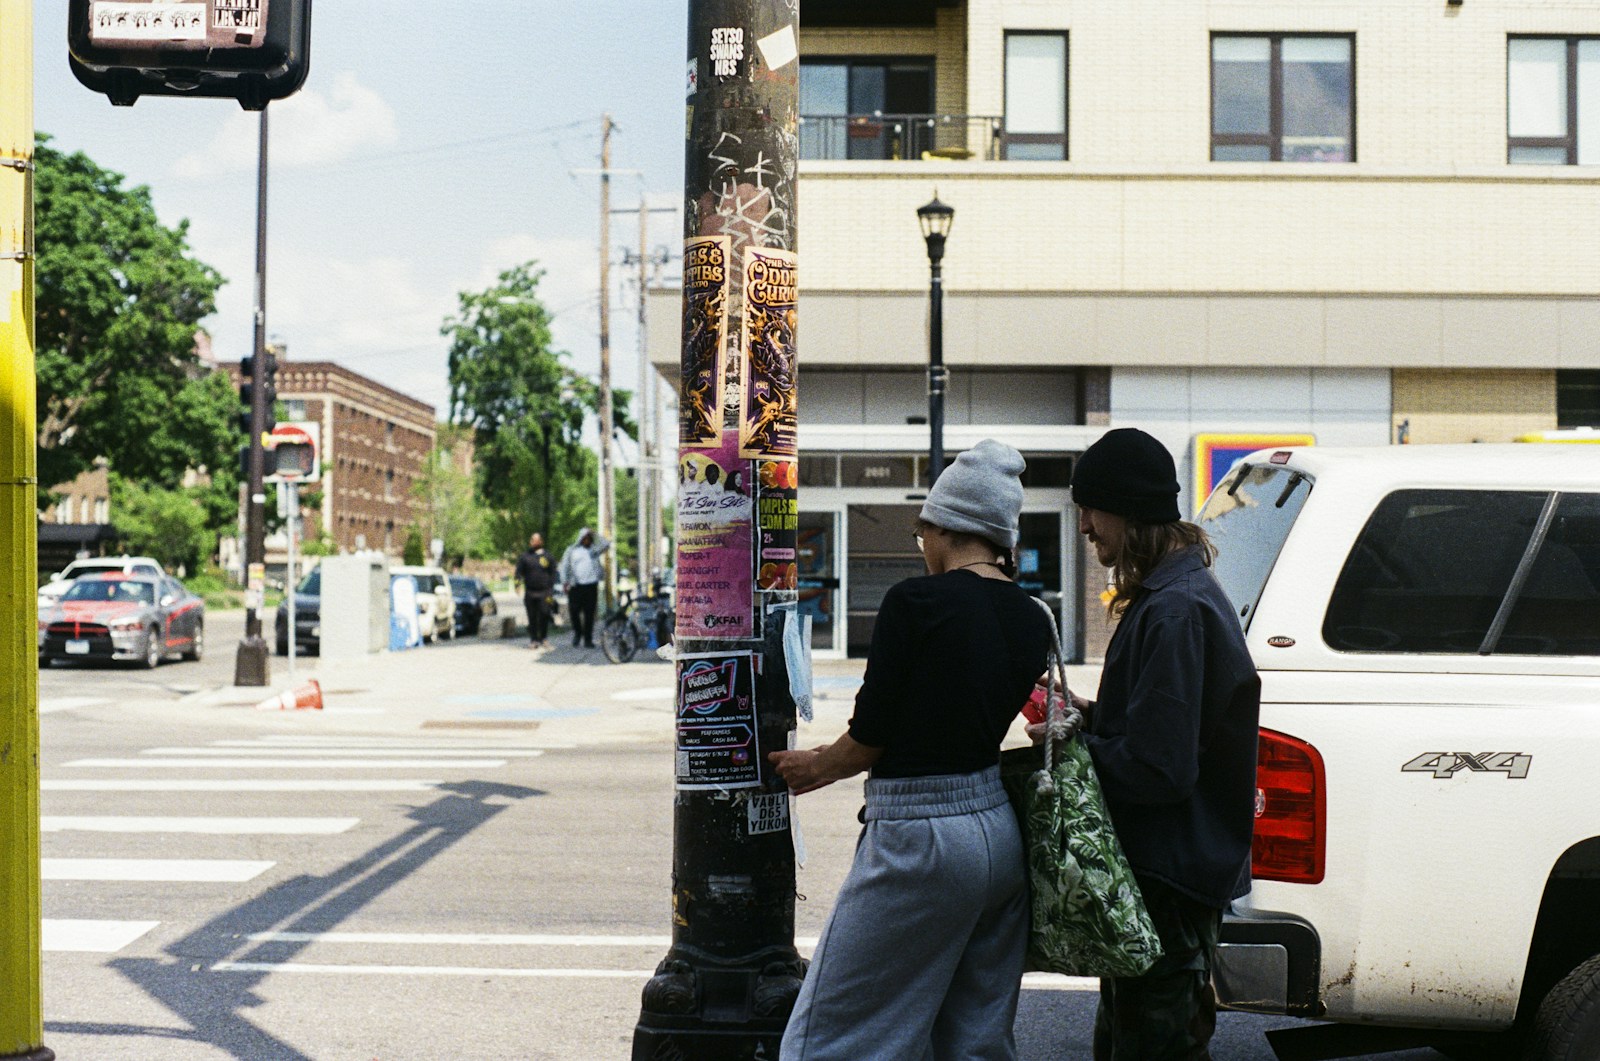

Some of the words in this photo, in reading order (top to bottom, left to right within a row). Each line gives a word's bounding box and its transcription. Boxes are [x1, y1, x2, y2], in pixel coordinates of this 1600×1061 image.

[714, 59, 737, 76] NBS
[691, 280, 709, 289] EXPO
[695, 496, 717, 509] Sun
[718, 495, 747, 509] Sets
[760, 499, 788, 514] MPLS
[760, 515, 783, 530] EDM
[695, 581, 731, 590] CARTER
[716, 616, 742, 625] KFAI
[752, 793, 787, 809] VAULT
[760, 806, 781, 820] D65
[751, 817, 788, 833] YUKON
